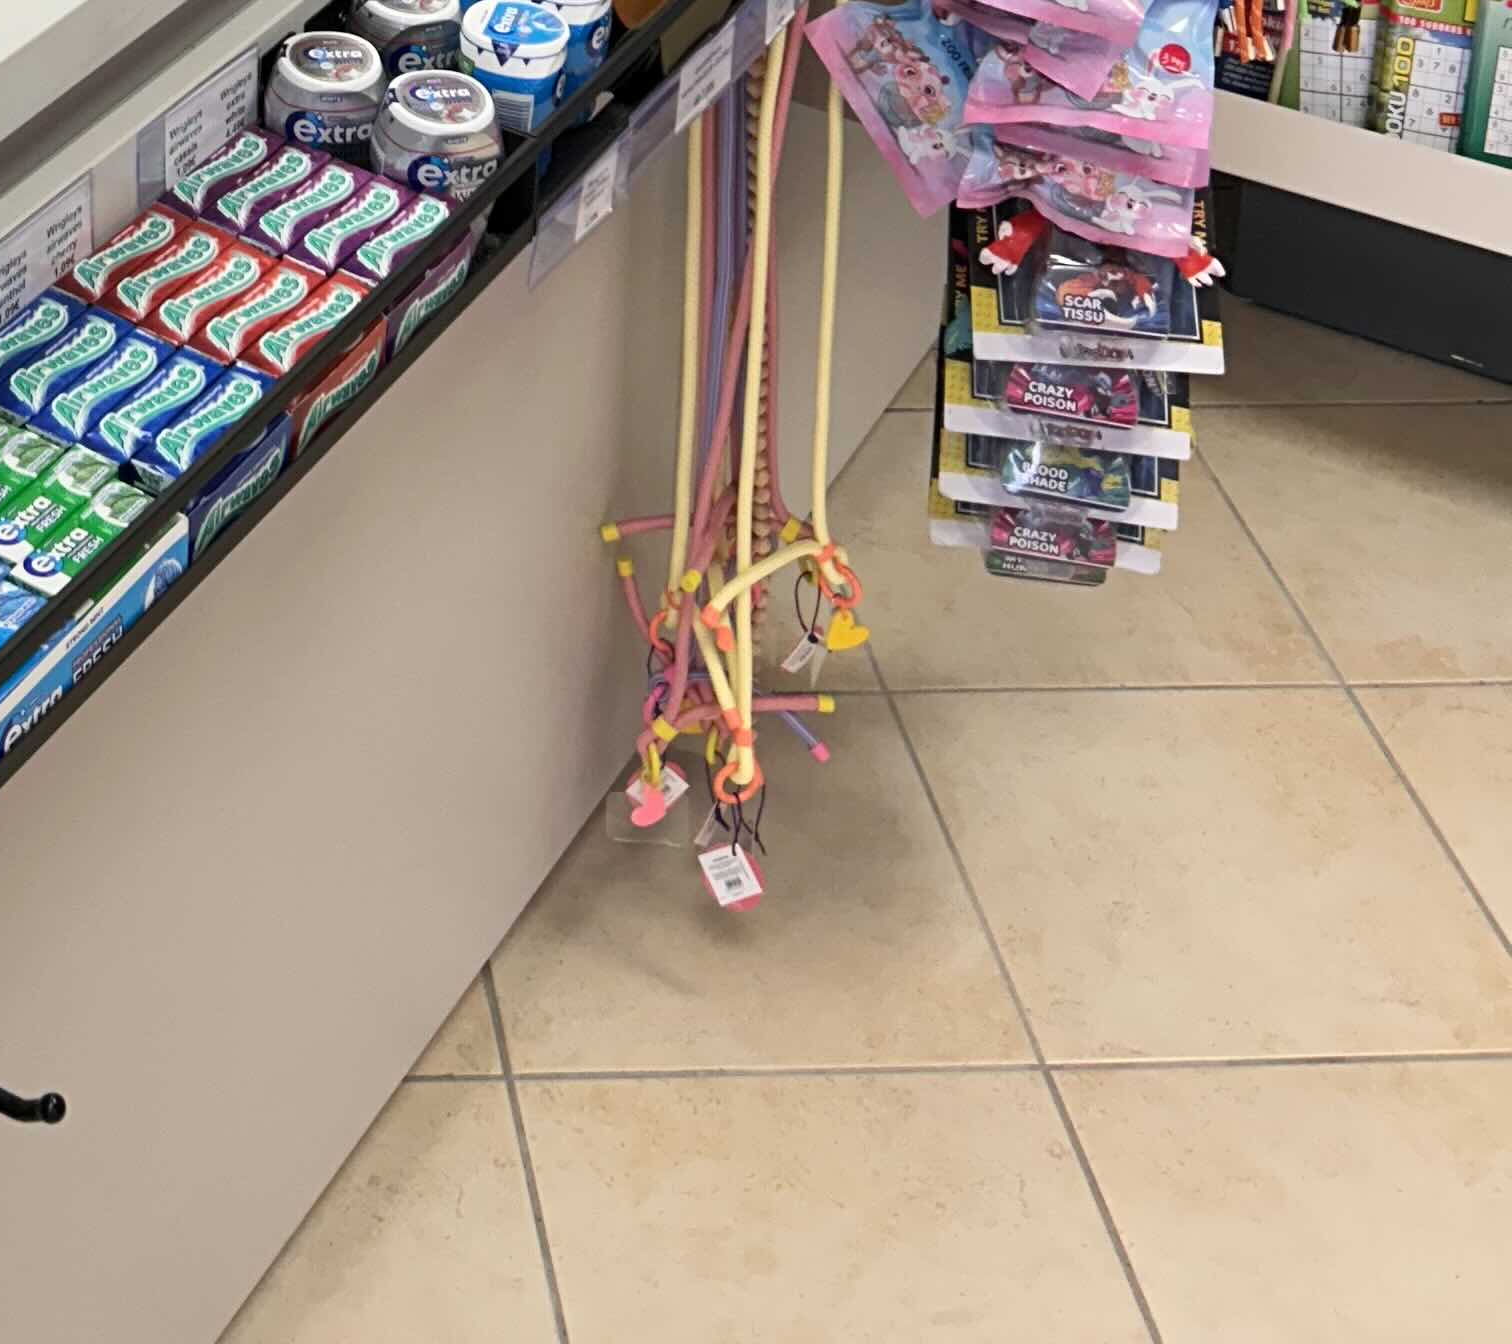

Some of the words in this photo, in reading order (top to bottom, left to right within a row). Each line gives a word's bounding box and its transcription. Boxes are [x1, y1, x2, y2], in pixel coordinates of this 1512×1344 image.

[309, 47, 363, 60] extra
[416, 86, 471, 99] extra
[293, 119, 371, 144] extra
[1064, 294, 1102, 310] SCAR
[1028, 382, 1074, 399] CRAZY
[1023, 392, 1076, 412] POISON
[1013, 526, 1057, 542] CRAZY
[1009, 535, 1060, 554] POISON
